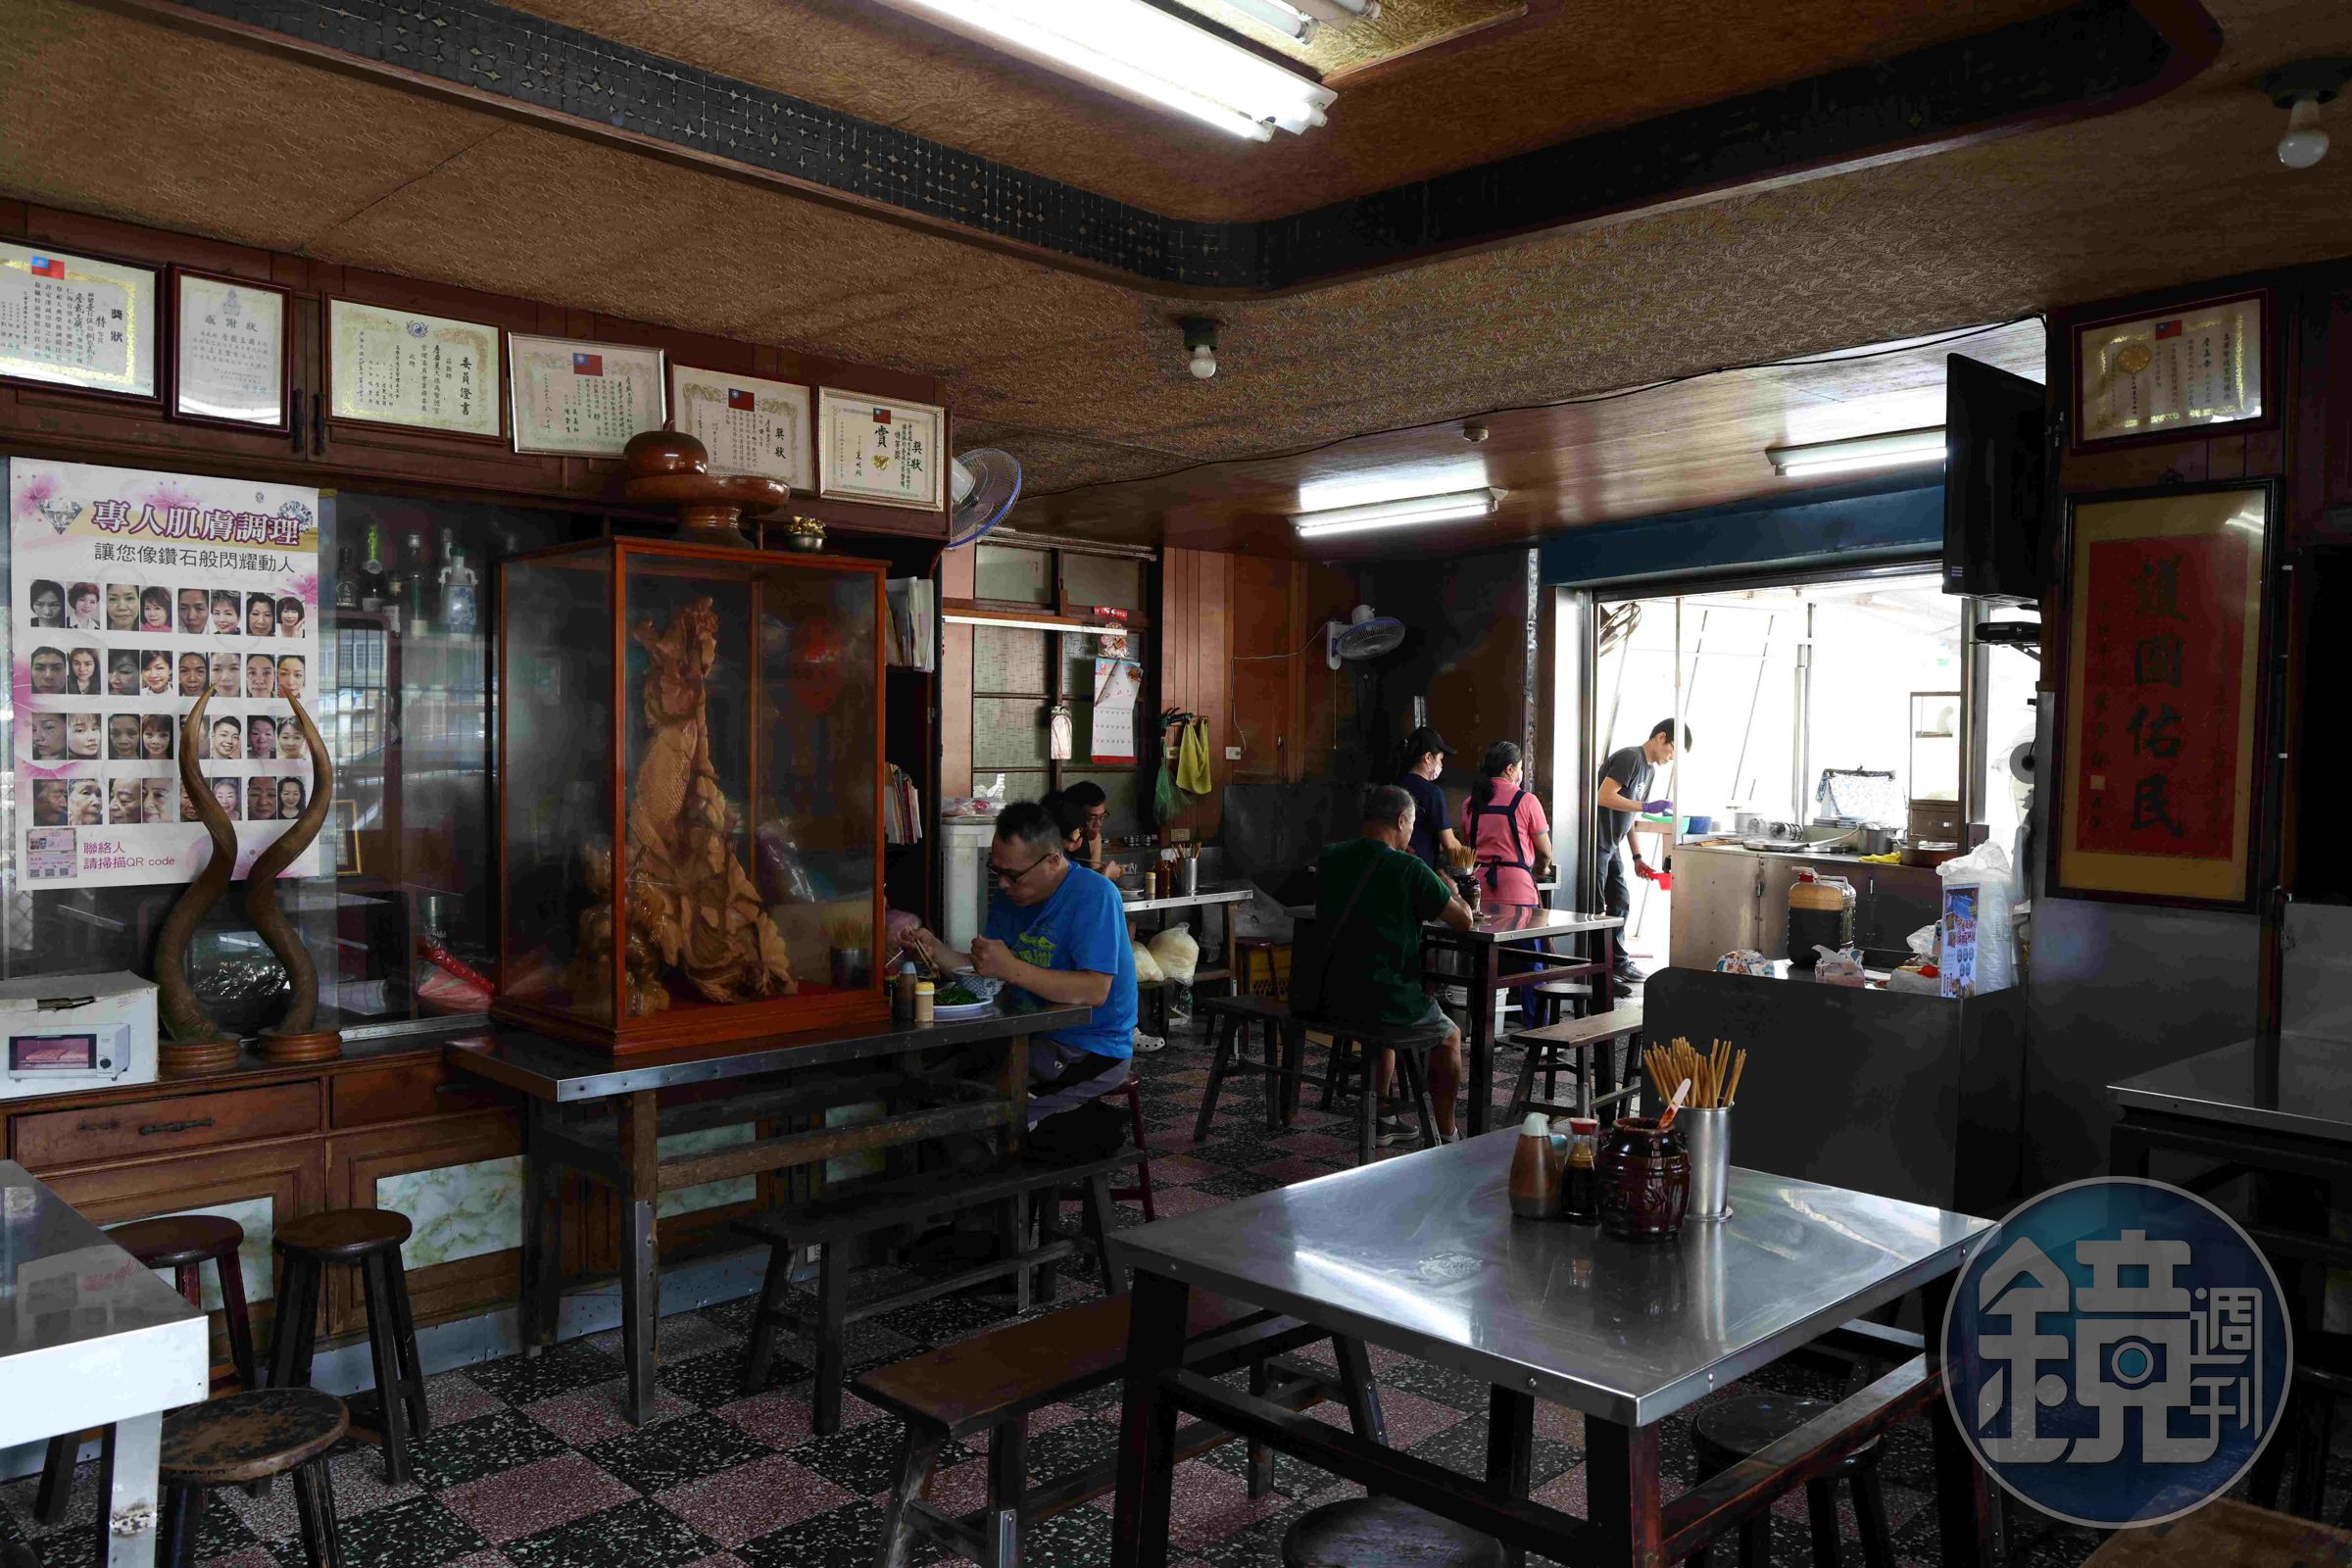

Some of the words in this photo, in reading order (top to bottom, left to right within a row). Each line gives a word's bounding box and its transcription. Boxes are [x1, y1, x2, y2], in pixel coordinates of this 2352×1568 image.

[110, 308, 123, 343] 獎狀
[205, 315, 259, 333] 感謝狀
[460, 356, 472, 416] 委員證書
[774, 427, 786, 460] 獎狀
[874, 424, 890, 448] 賞
[909, 440, 923, 472] 獎狀
[92, 499, 302, 546] 專人肌膚調理
[94, 542, 295, 573] 讓您像鑽石般閃耀動人
[83, 842, 125, 855] 聯絡人
[83, 857, 144, 870] 請掃描QR
[148, 856, 175, 866] code
